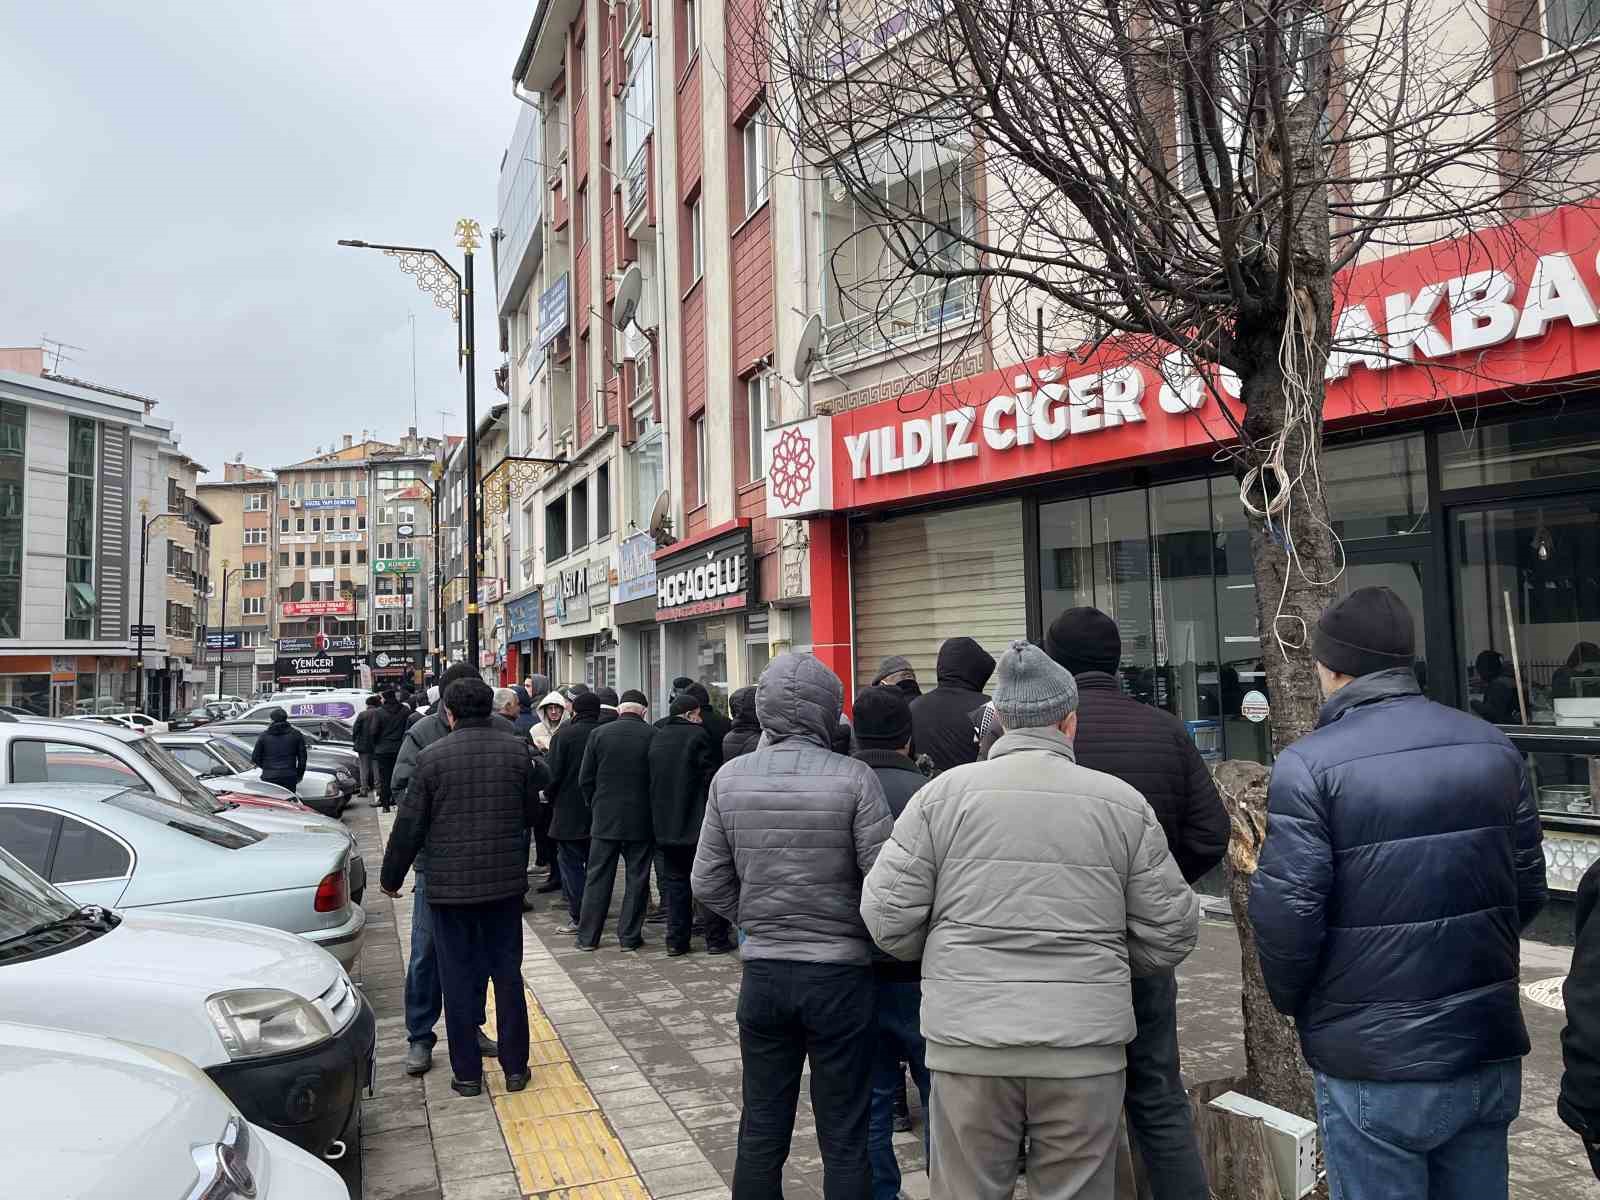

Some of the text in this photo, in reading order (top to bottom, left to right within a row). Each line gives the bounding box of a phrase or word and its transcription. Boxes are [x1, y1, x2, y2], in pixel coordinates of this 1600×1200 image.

[843, 405, 979, 480] YILDIZ
[983, 364, 1148, 451] CİĞER
[657, 550, 740, 608] HOCAOĞLU
